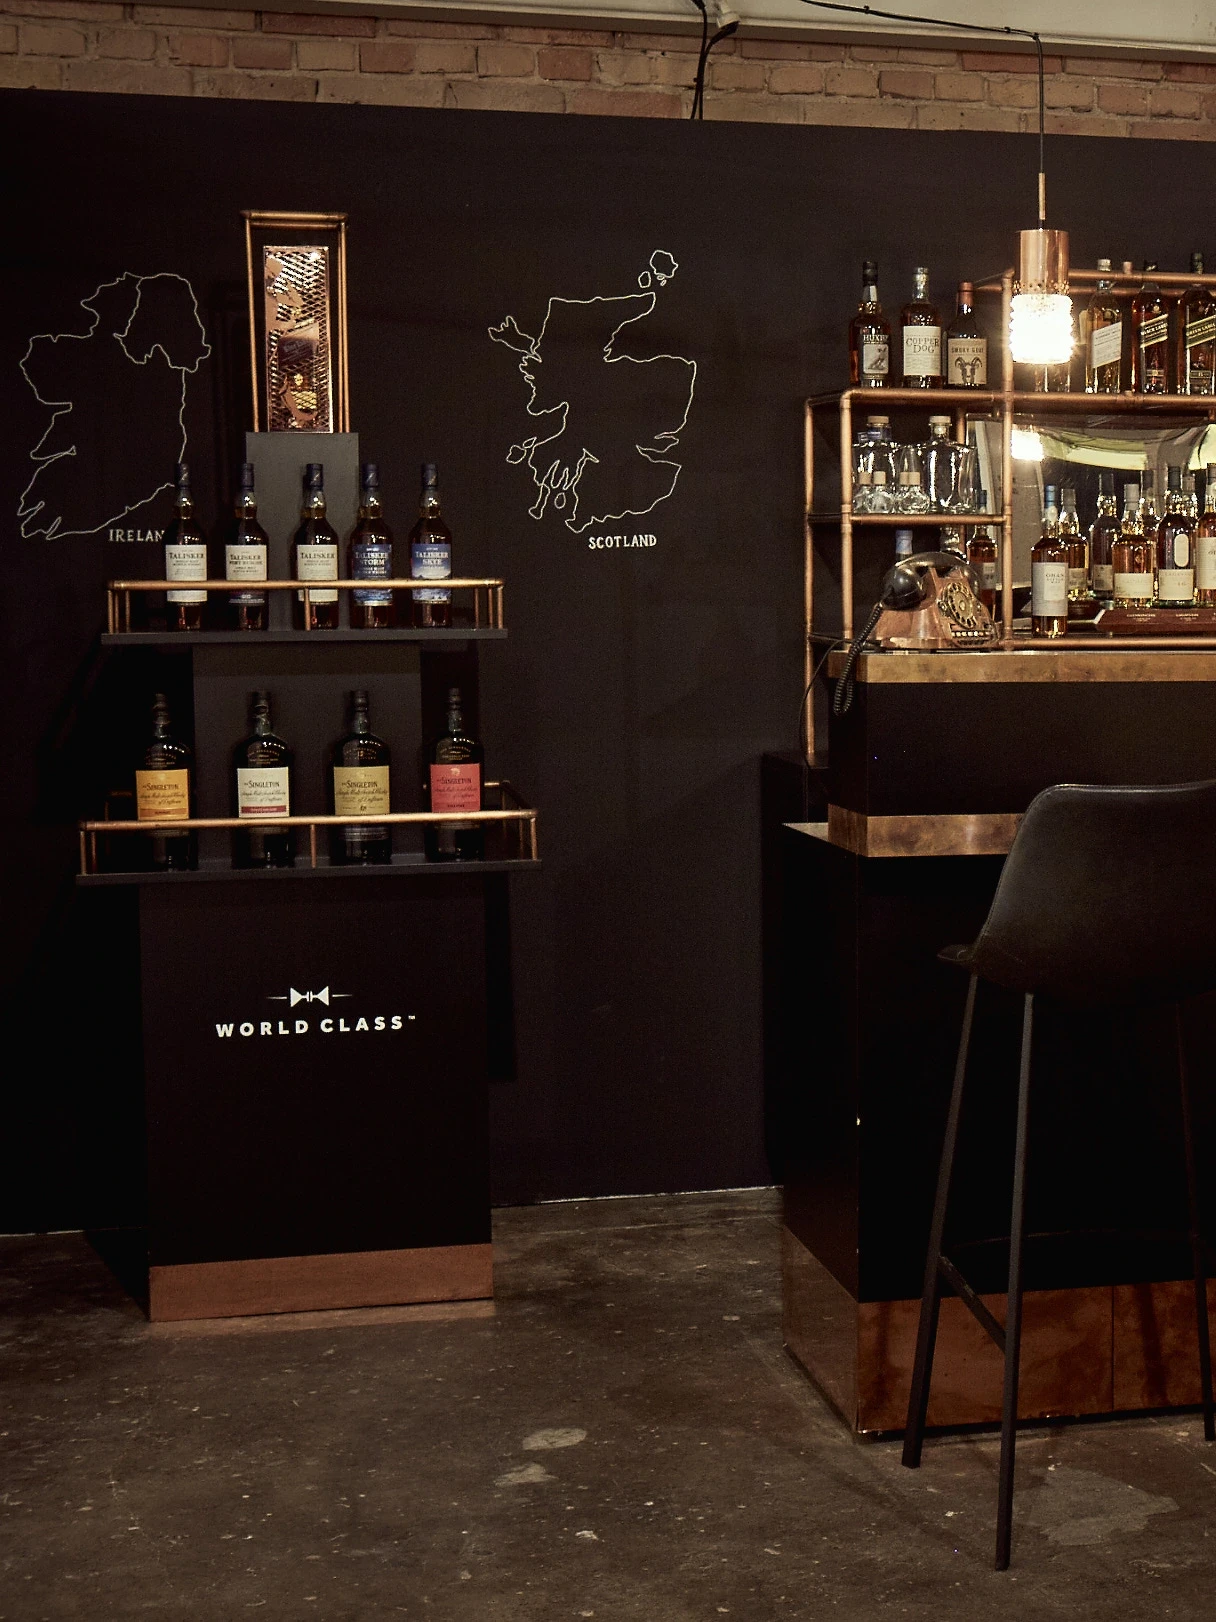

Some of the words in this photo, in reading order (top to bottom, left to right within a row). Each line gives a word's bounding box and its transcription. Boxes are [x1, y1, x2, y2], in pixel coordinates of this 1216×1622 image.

[906, 337, 939, 348] COPPER
[913, 345, 935, 354] DOG
[108, 529, 166, 543] IRELAN
[589, 534, 657, 549] SCOTLAND
[169, 552, 205, 560] TALISKER
[300, 552, 336, 560] TALISKER
[415, 551, 449, 559] TALISKER
[247, 780, 280, 788] SINGLETON
[346, 780, 378, 788] SINGLETON
[441, 777, 472, 785] SINGLETON
[146, 783, 179, 791] SINGLETON
[215, 1020, 309, 1038] WORLD
